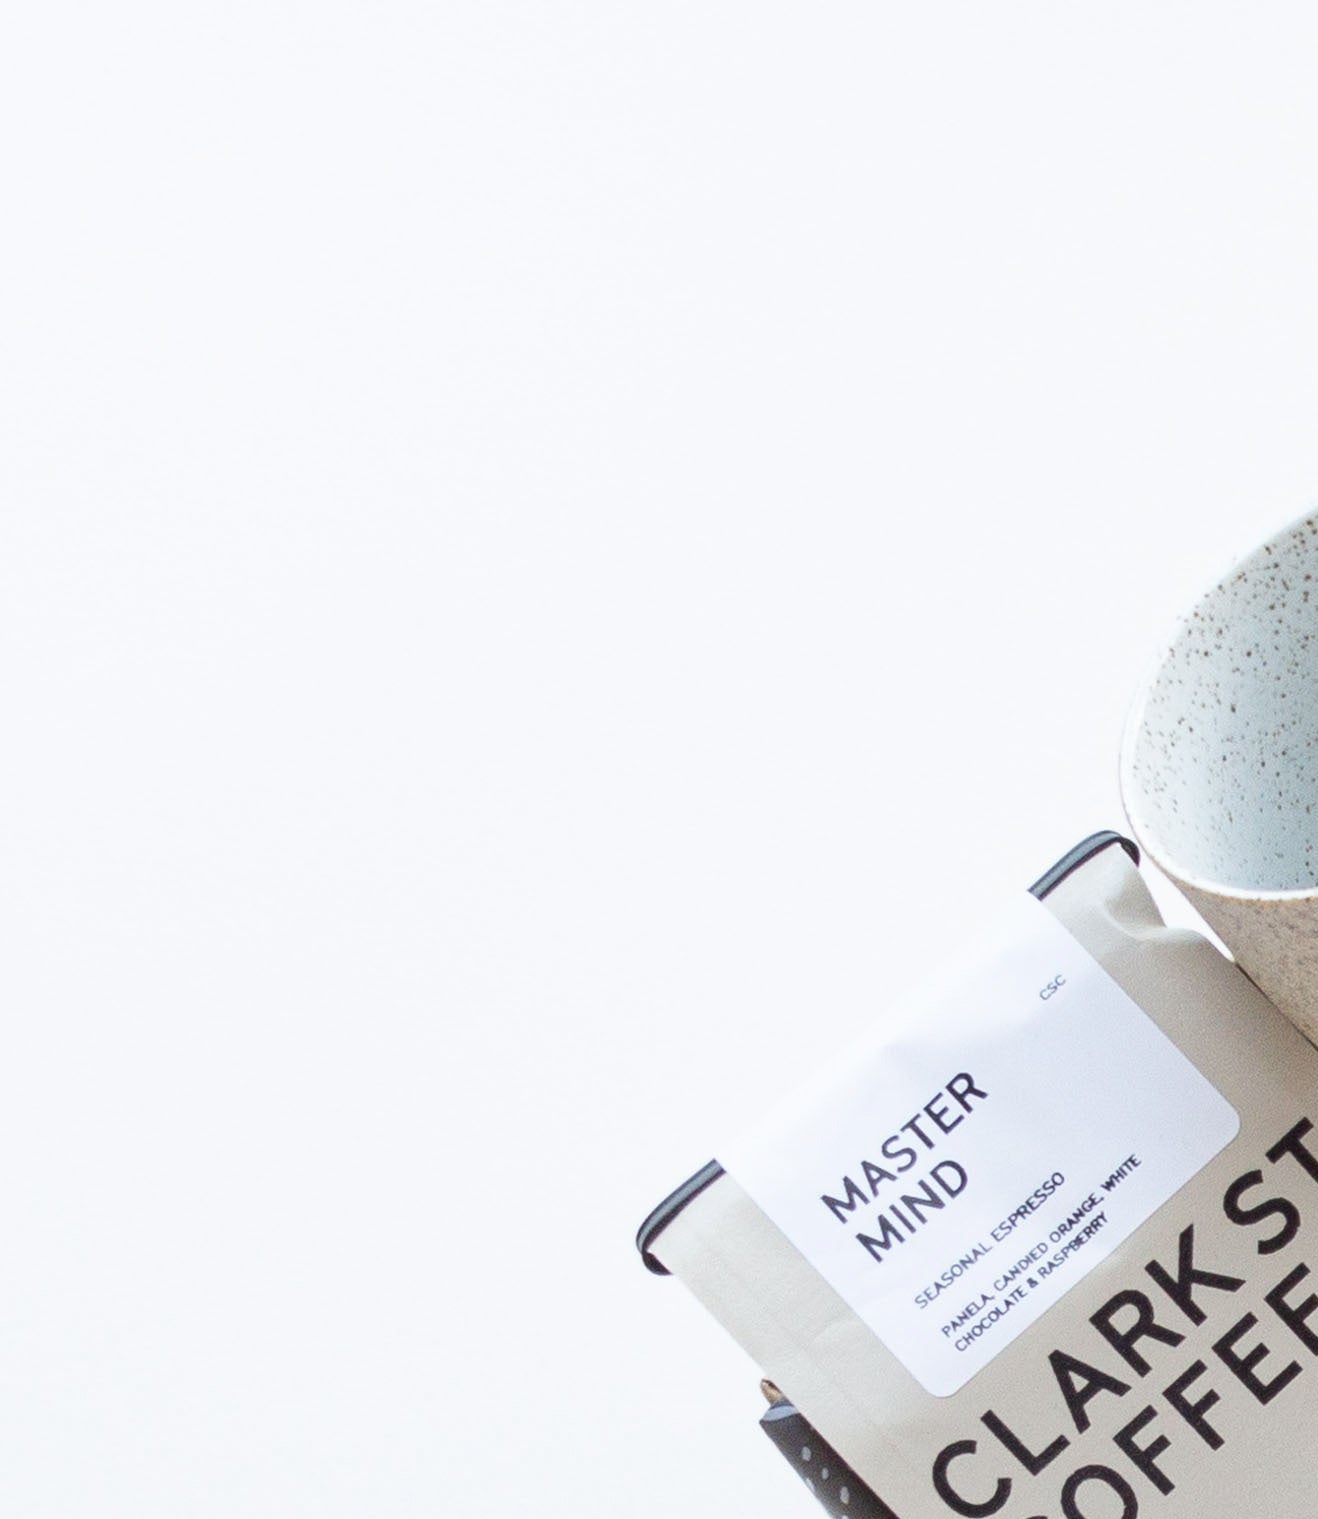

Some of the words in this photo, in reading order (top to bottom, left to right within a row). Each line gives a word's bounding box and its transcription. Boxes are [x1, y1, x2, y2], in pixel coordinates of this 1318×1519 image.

[1039, 974, 1067, 1001] CSC
[820, 1072, 988, 1225] MASTER
[855, 1159, 969, 1263] MIND
[914, 1243, 993, 1309] SEASONAL
[990, 1171, 1065, 1242] ESPRESSO
[941, 1293, 995, 1338] PANELA,
[994, 1242, 1049, 1292] CANDIED
[1100, 1153, 1142, 1192] WHITE
[954, 1285, 1027, 1352] CHOCOLATE
[1026, 1277, 1039, 1289] &
[1037, 1211, 1109, 1279] RASPBERRY
[932, 1223, 1246, 1519] CLARK
